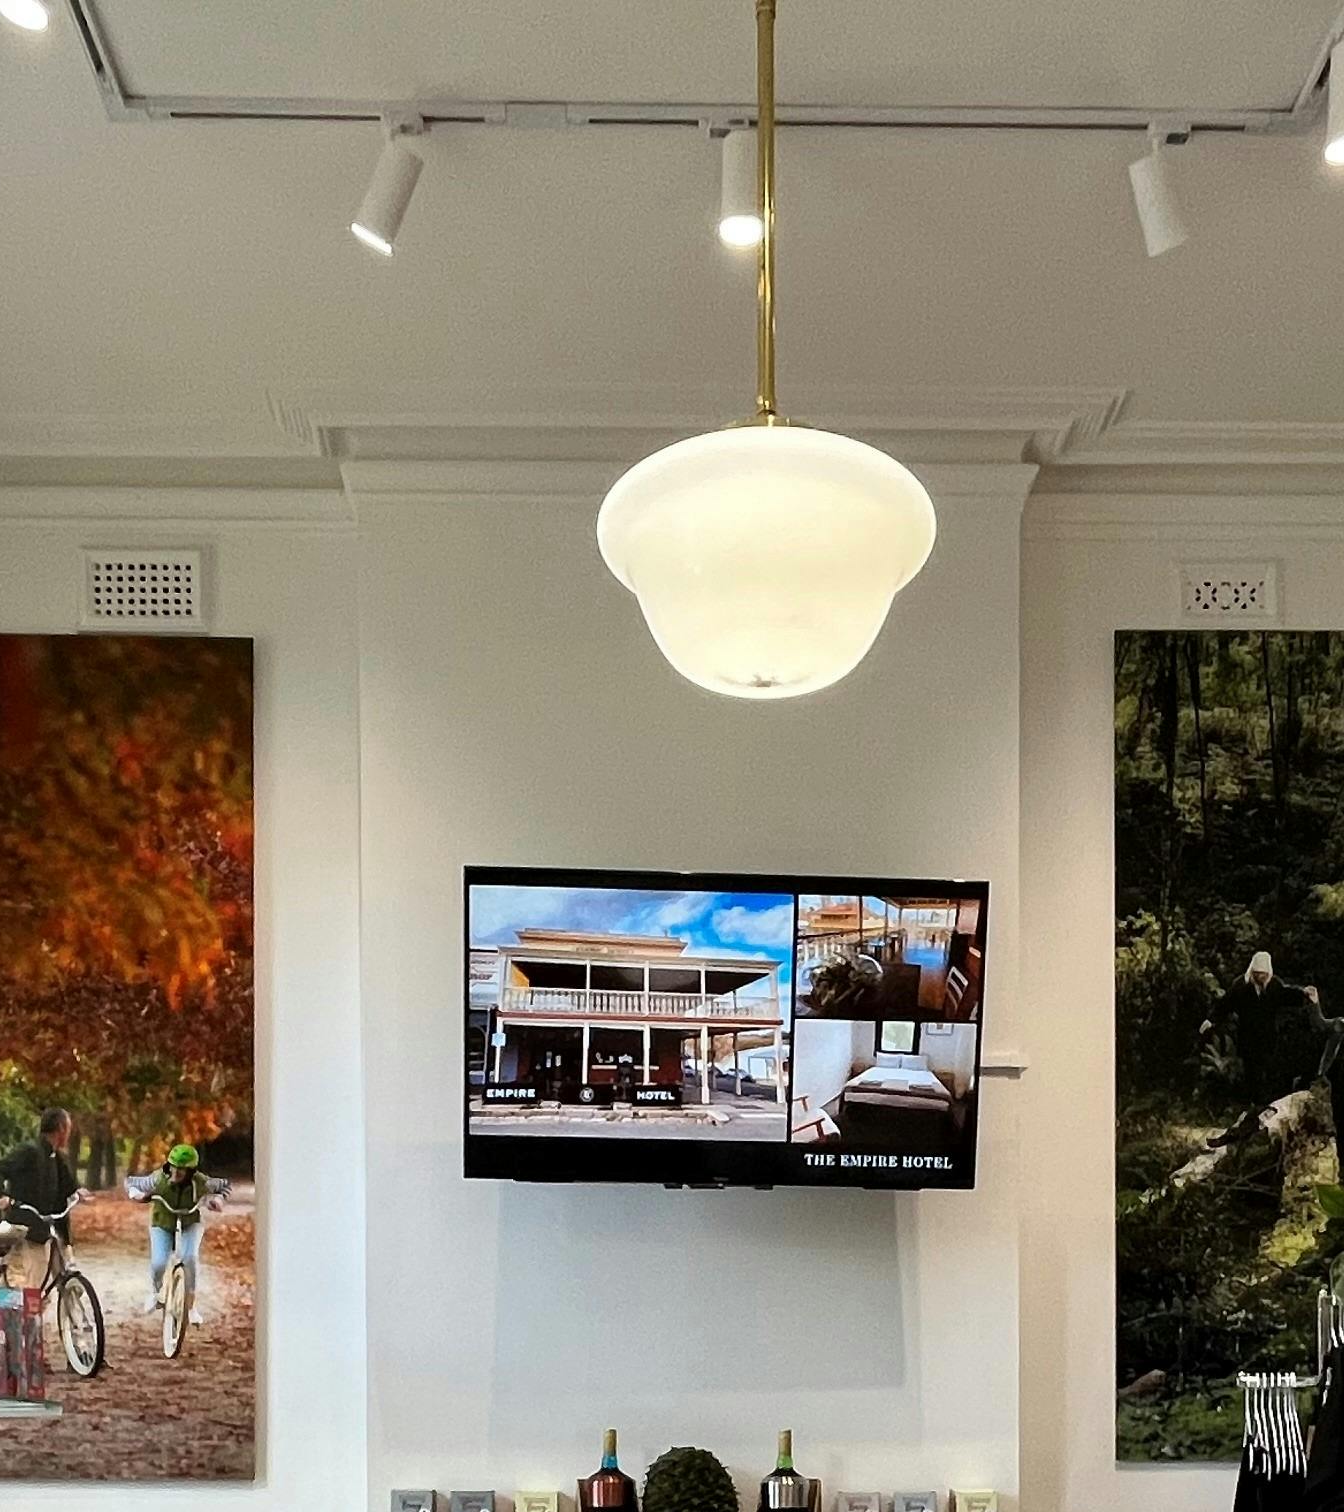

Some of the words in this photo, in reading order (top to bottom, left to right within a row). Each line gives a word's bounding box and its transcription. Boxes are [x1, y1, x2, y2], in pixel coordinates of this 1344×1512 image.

[486, 1088, 536, 1098] EMPIRE
[636, 1091, 675, 1100] HOTEL
[803, 1153, 836, 1166] THE
[840, 1154, 898, 1168] EMPIRE
[902, 1156, 953, 1169] HOTEL
